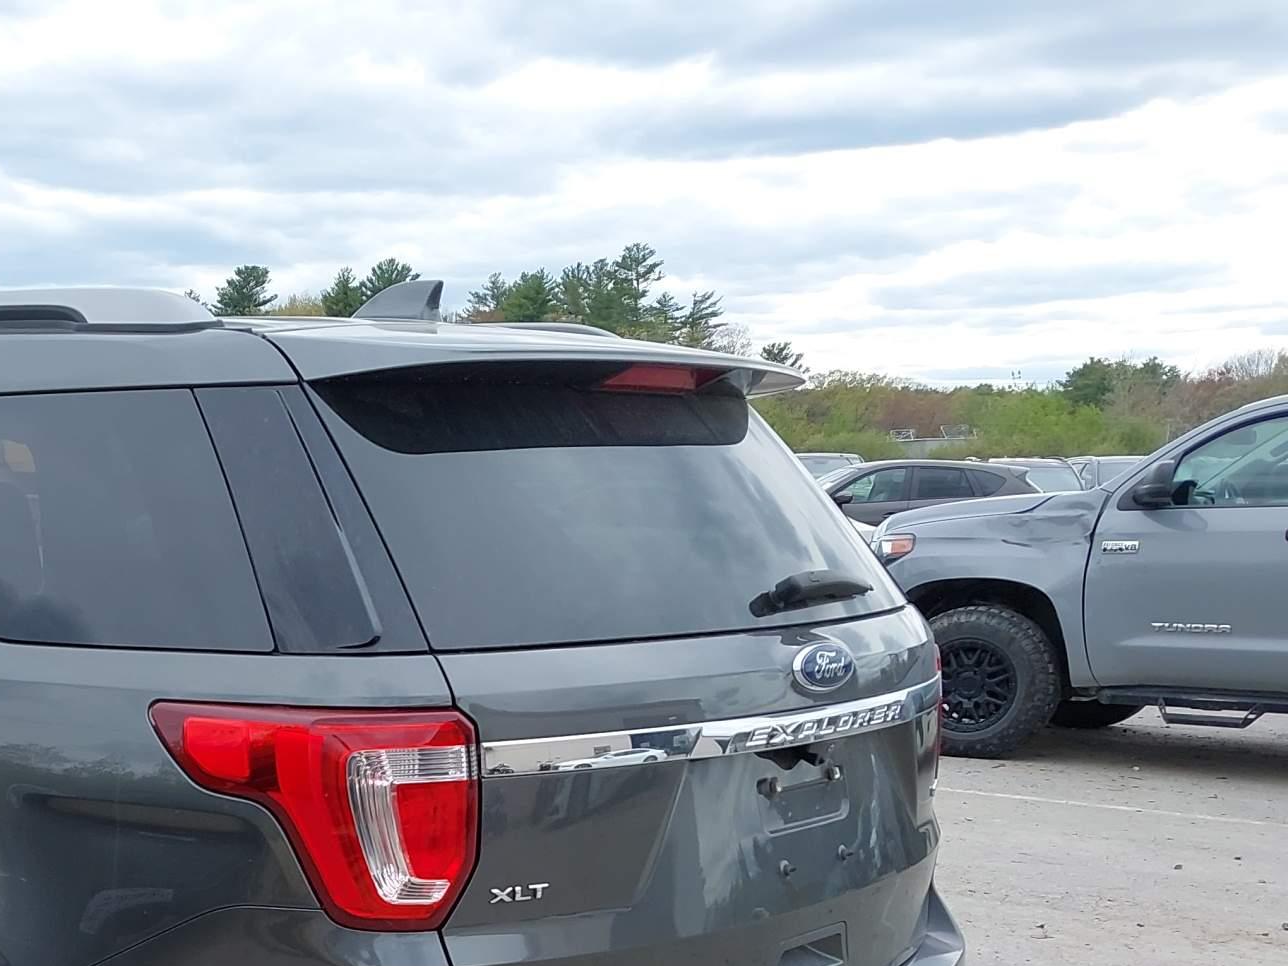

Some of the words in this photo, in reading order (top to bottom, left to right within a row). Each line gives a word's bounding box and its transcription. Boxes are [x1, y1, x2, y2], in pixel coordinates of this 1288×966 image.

[1151, 622, 1231, 633] TUNDRA
[814, 650, 846, 679] Ford
[745, 703, 903, 748] EXPLORER
[490, 883, 550, 904] XLT
